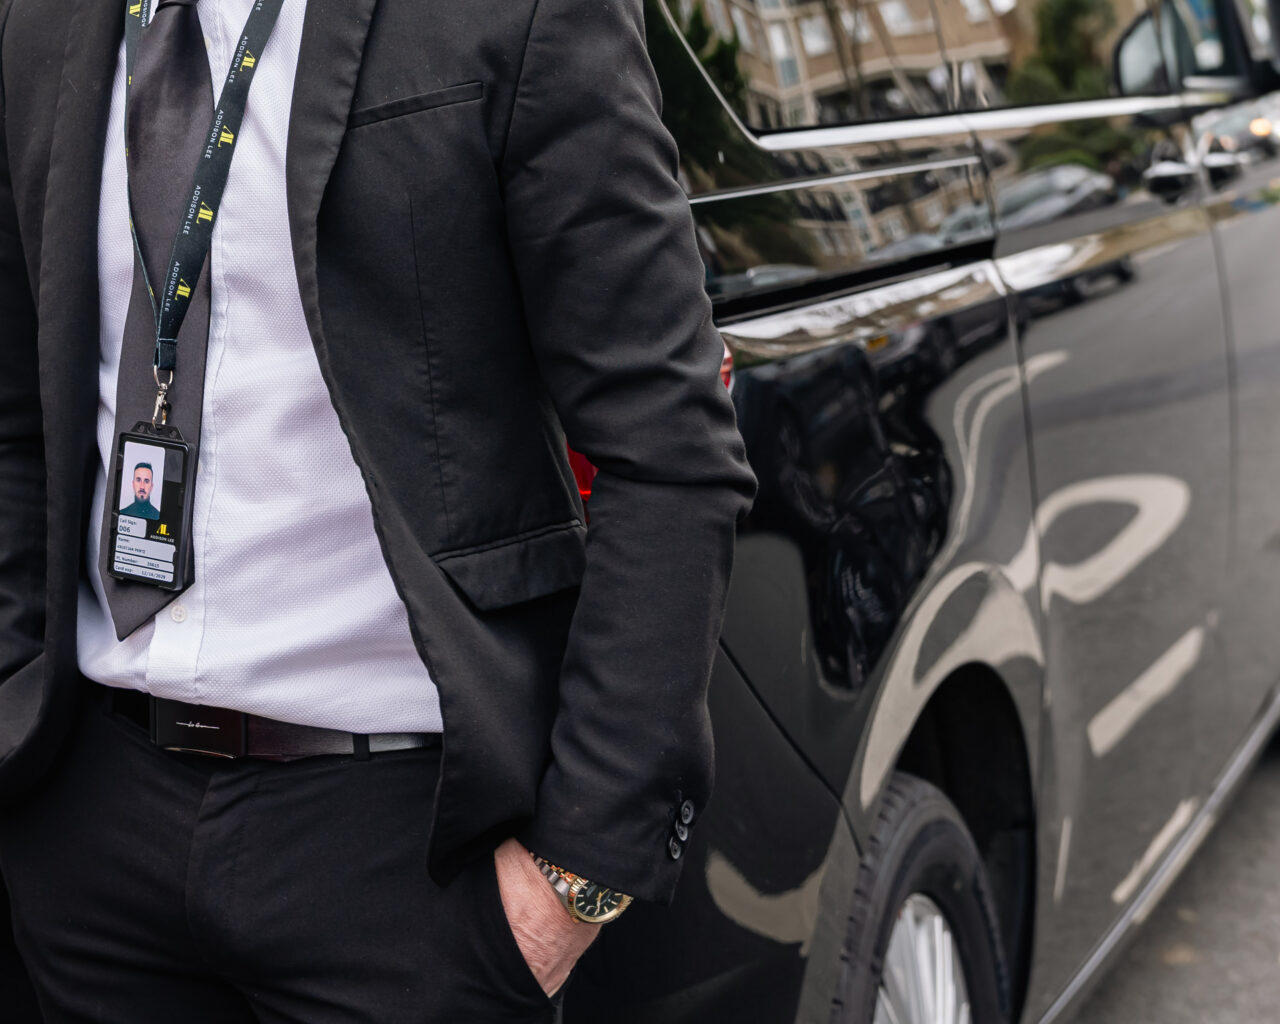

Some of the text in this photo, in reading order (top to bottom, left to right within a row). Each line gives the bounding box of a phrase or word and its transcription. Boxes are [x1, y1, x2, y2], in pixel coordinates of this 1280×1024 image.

[228, 36, 248, 84] ADDISON LEE
[204, 109, 224, 159] ADDISON LEE
[182, 184, 202, 235] ADDISON LEE
[167, 261, 180, 296] ADDISON
